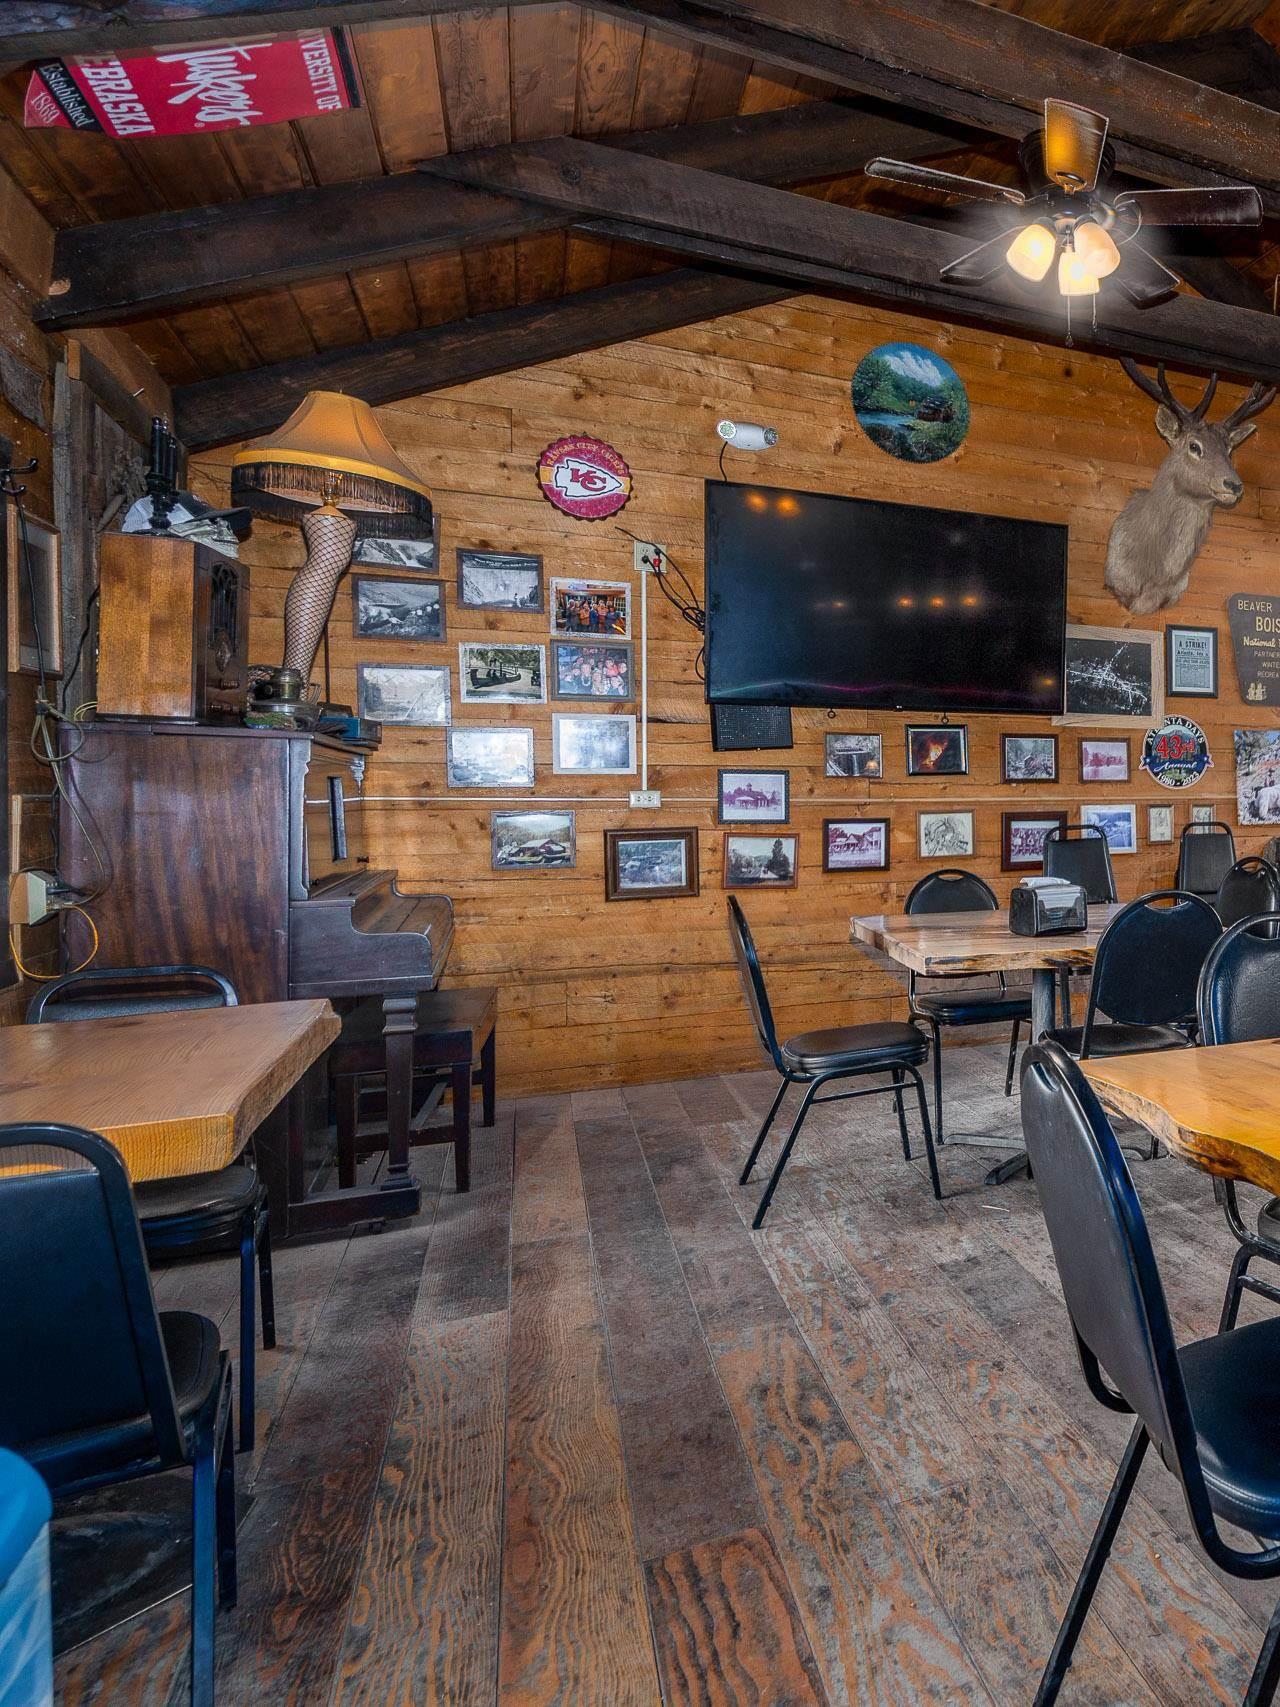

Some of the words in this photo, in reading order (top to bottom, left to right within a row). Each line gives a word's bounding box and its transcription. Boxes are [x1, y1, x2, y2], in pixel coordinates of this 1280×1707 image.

[39, 62, 95, 128] Established
[316, 94, 343, 110] OF
[29, 91, 61, 124] 1869
[546, 443, 575, 466] KANSAS
[576, 442, 599, 451] CITY
[570, 468, 607, 492] KC
[1237, 600, 1272, 613] BEAVER
[1243, 636, 1276, 648] National
[1147, 717, 1183, 745] ATLNTA
[1185, 722, 1205, 744] DAYS
[1156, 735, 1196, 759] 43rd
[1153, 761, 1198, 772] Annual
